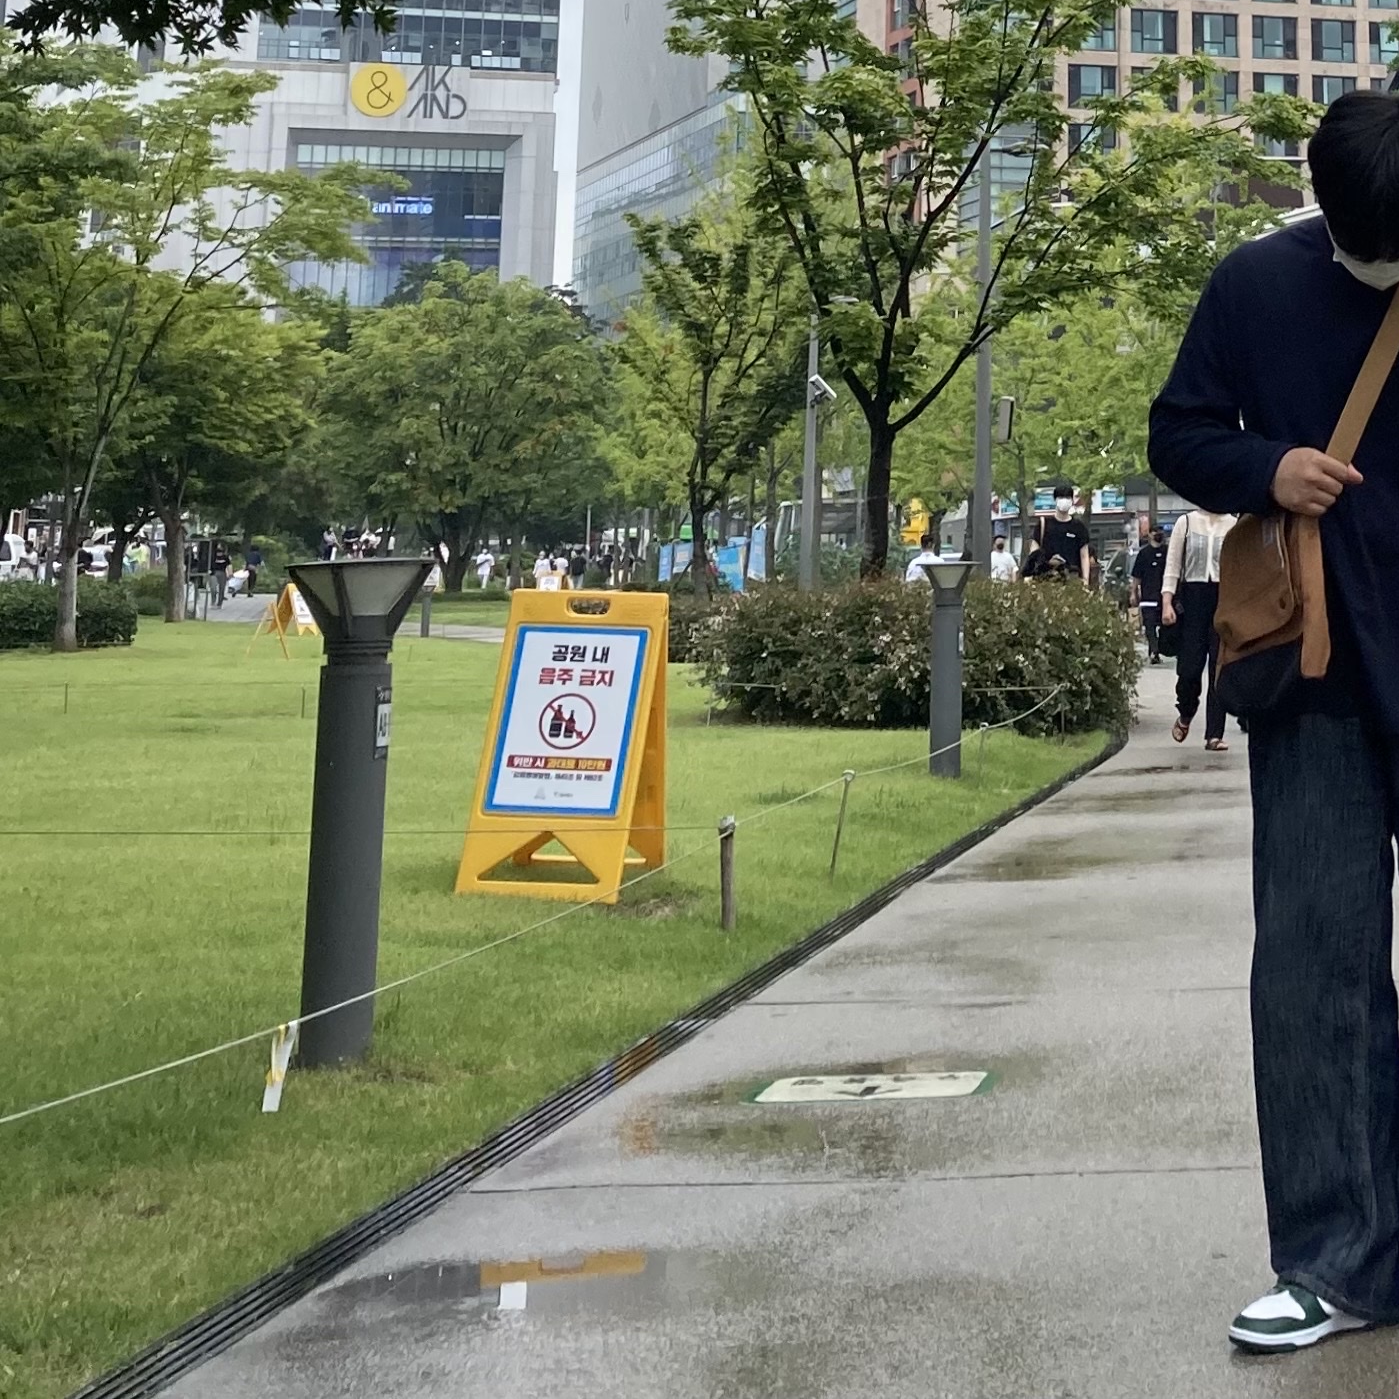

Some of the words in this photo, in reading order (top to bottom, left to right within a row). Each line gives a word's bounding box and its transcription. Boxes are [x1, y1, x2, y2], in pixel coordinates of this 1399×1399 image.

[407, 64, 453, 93] AK
[406, 93, 468, 120] AND
[371, 201, 433, 215] animate
[552, 644, 588, 663] 공원
[591, 646, 611, 664] 내
[539, 667, 574, 686] 음주
[578, 669, 615, 687] 금지
[513, 756, 534, 768] 위반
[535, 757, 546, 768] 시
